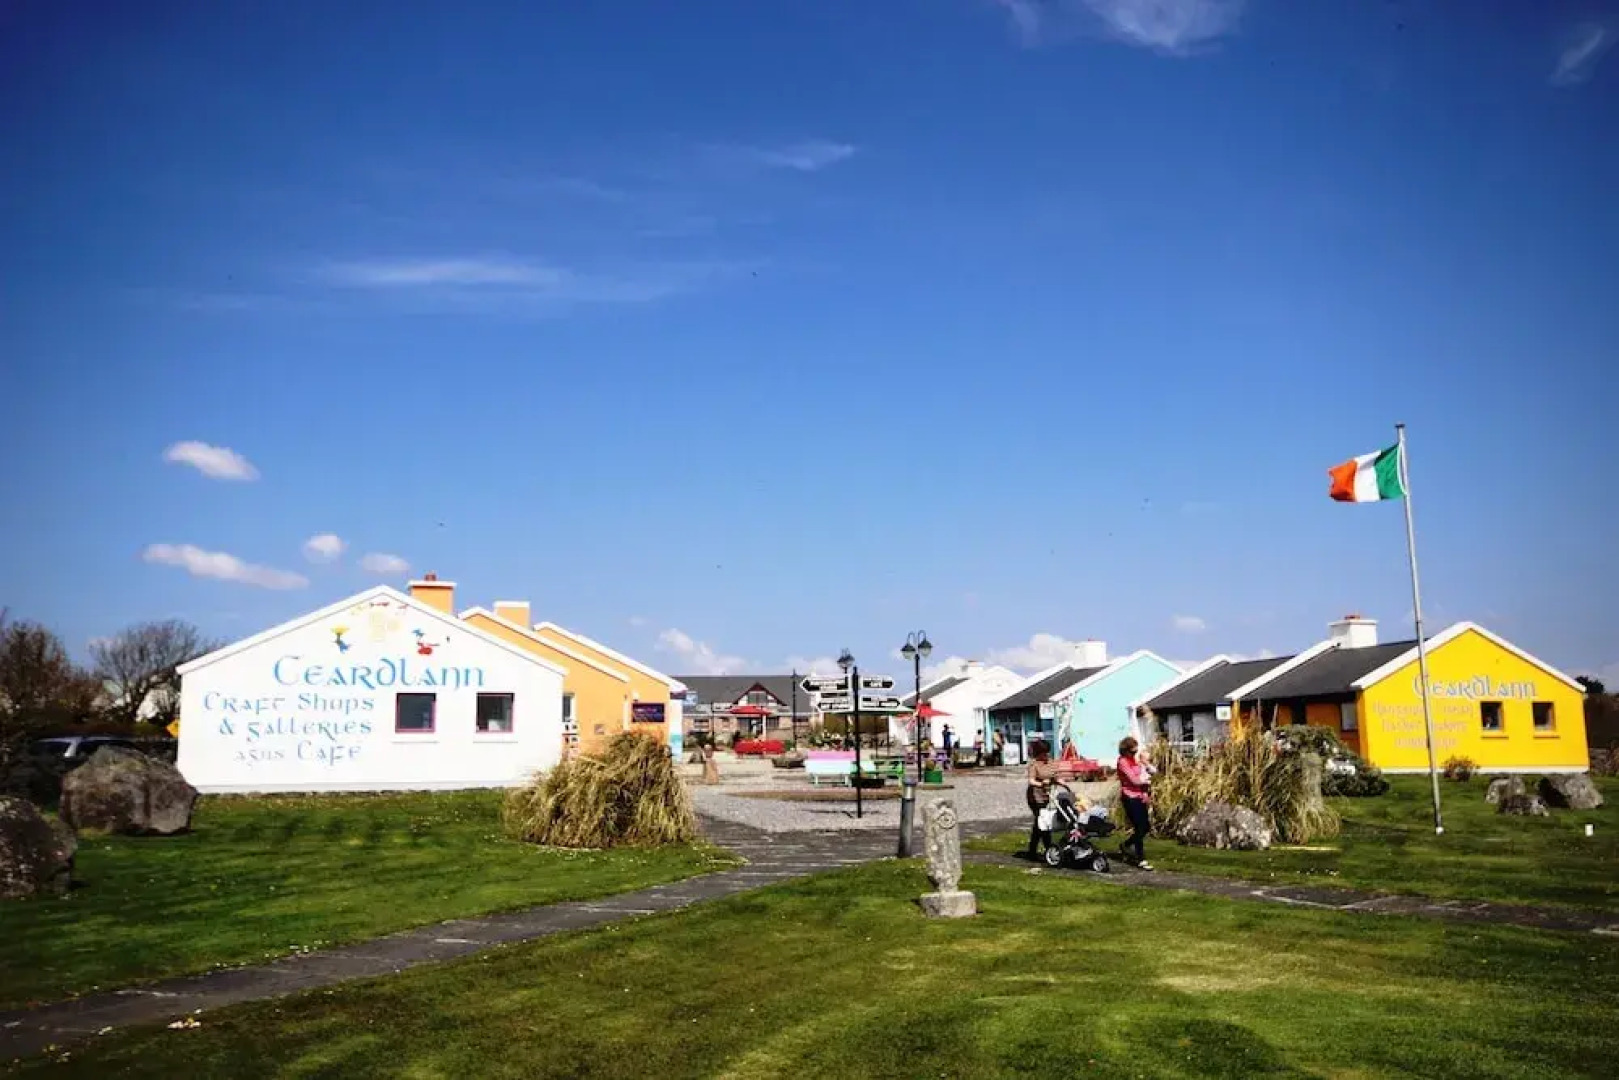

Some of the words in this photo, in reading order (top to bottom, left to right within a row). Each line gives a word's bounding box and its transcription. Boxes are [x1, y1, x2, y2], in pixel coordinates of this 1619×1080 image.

[273, 655, 484, 690] Ceardlann
[297, 692, 375, 715] Shops
[219, 717, 235, 735] &
